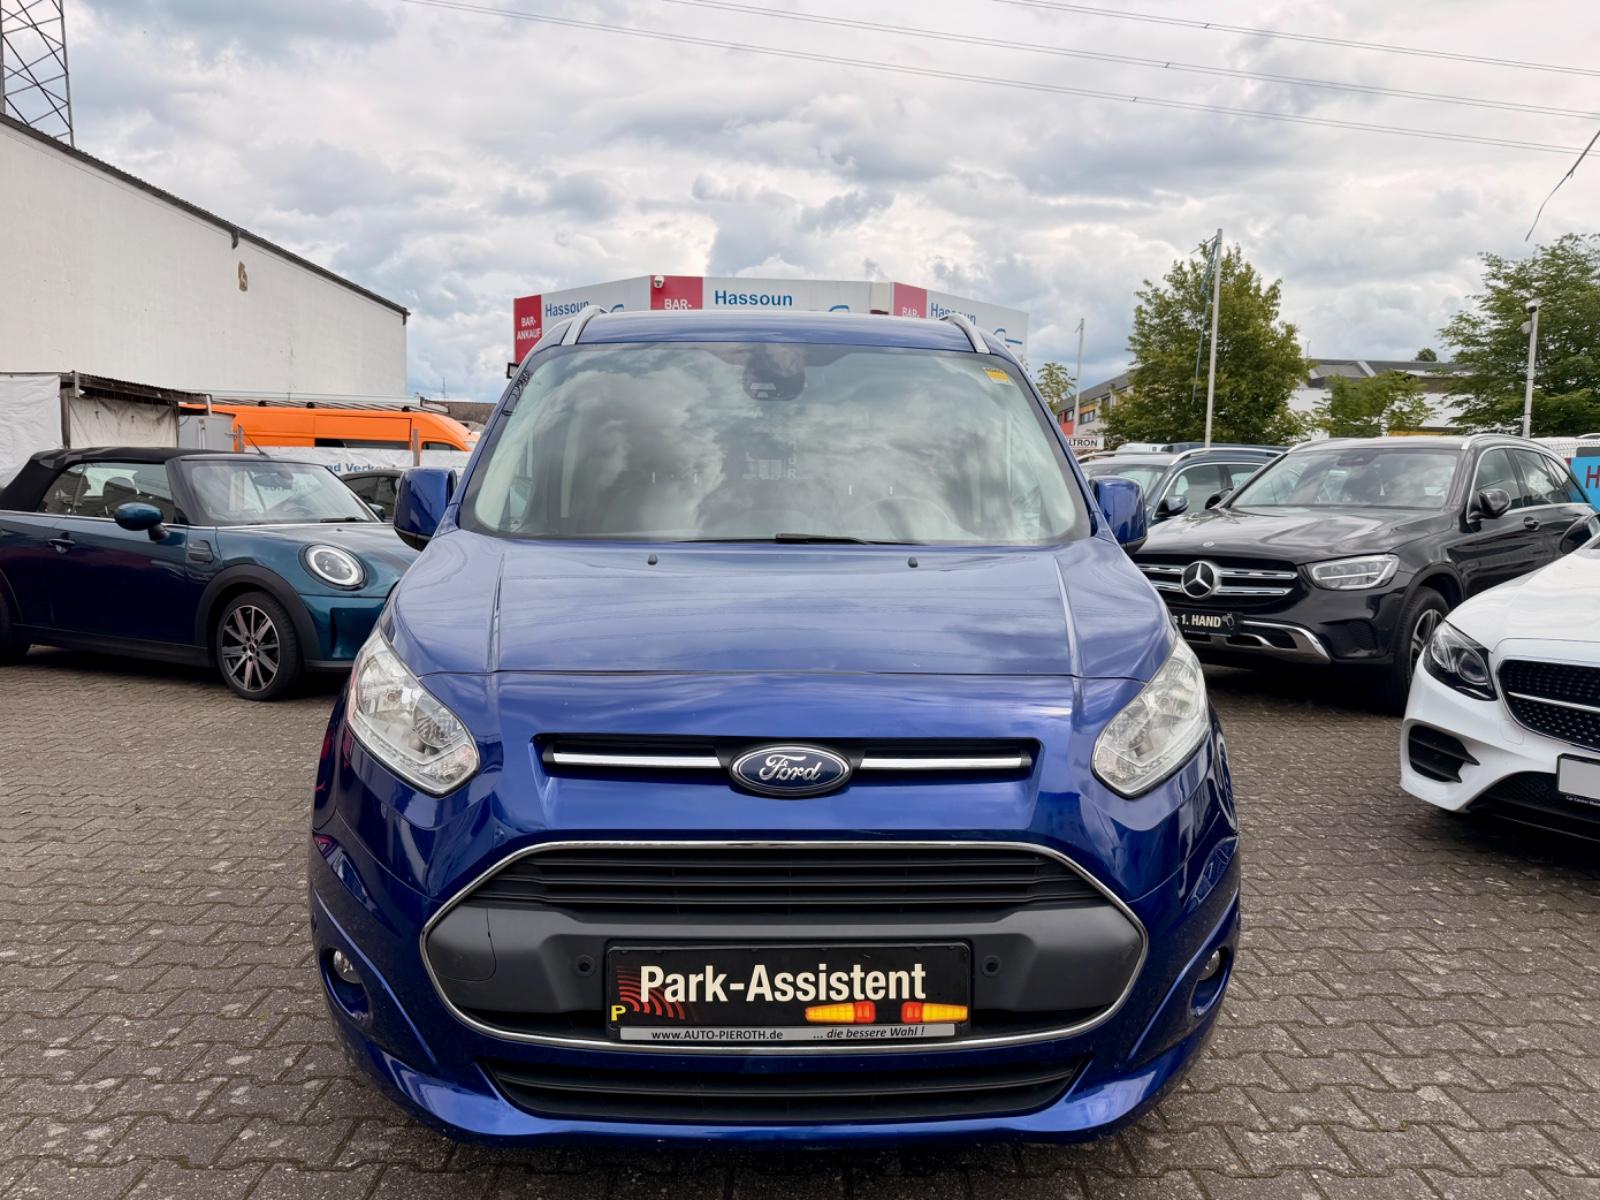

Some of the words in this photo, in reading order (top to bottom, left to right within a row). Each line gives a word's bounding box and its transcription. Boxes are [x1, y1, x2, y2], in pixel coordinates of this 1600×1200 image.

[664, 298, 693, 310] BAR-
[714, 290, 793, 306] Hassoun
[930, 302, 976, 326] Hasun
[521, 316, 537, 327] BAR-
[517, 328, 541, 340] ANKAUF
[1181, 614, 1189, 625] 1.
[1191, 615, 1221, 628] HAND
[759, 754, 822, 781] Ford
[640, 963, 926, 1003] Park-Assistent
[611, 1005, 626, 1021] P
[651, 1029, 783, 1041] www.AUTO-PIEROTH.de
[826, 1029, 843, 1039] die
[846, 1028, 887, 1039] bessere
[890, 1026, 918, 1037] Wahl
